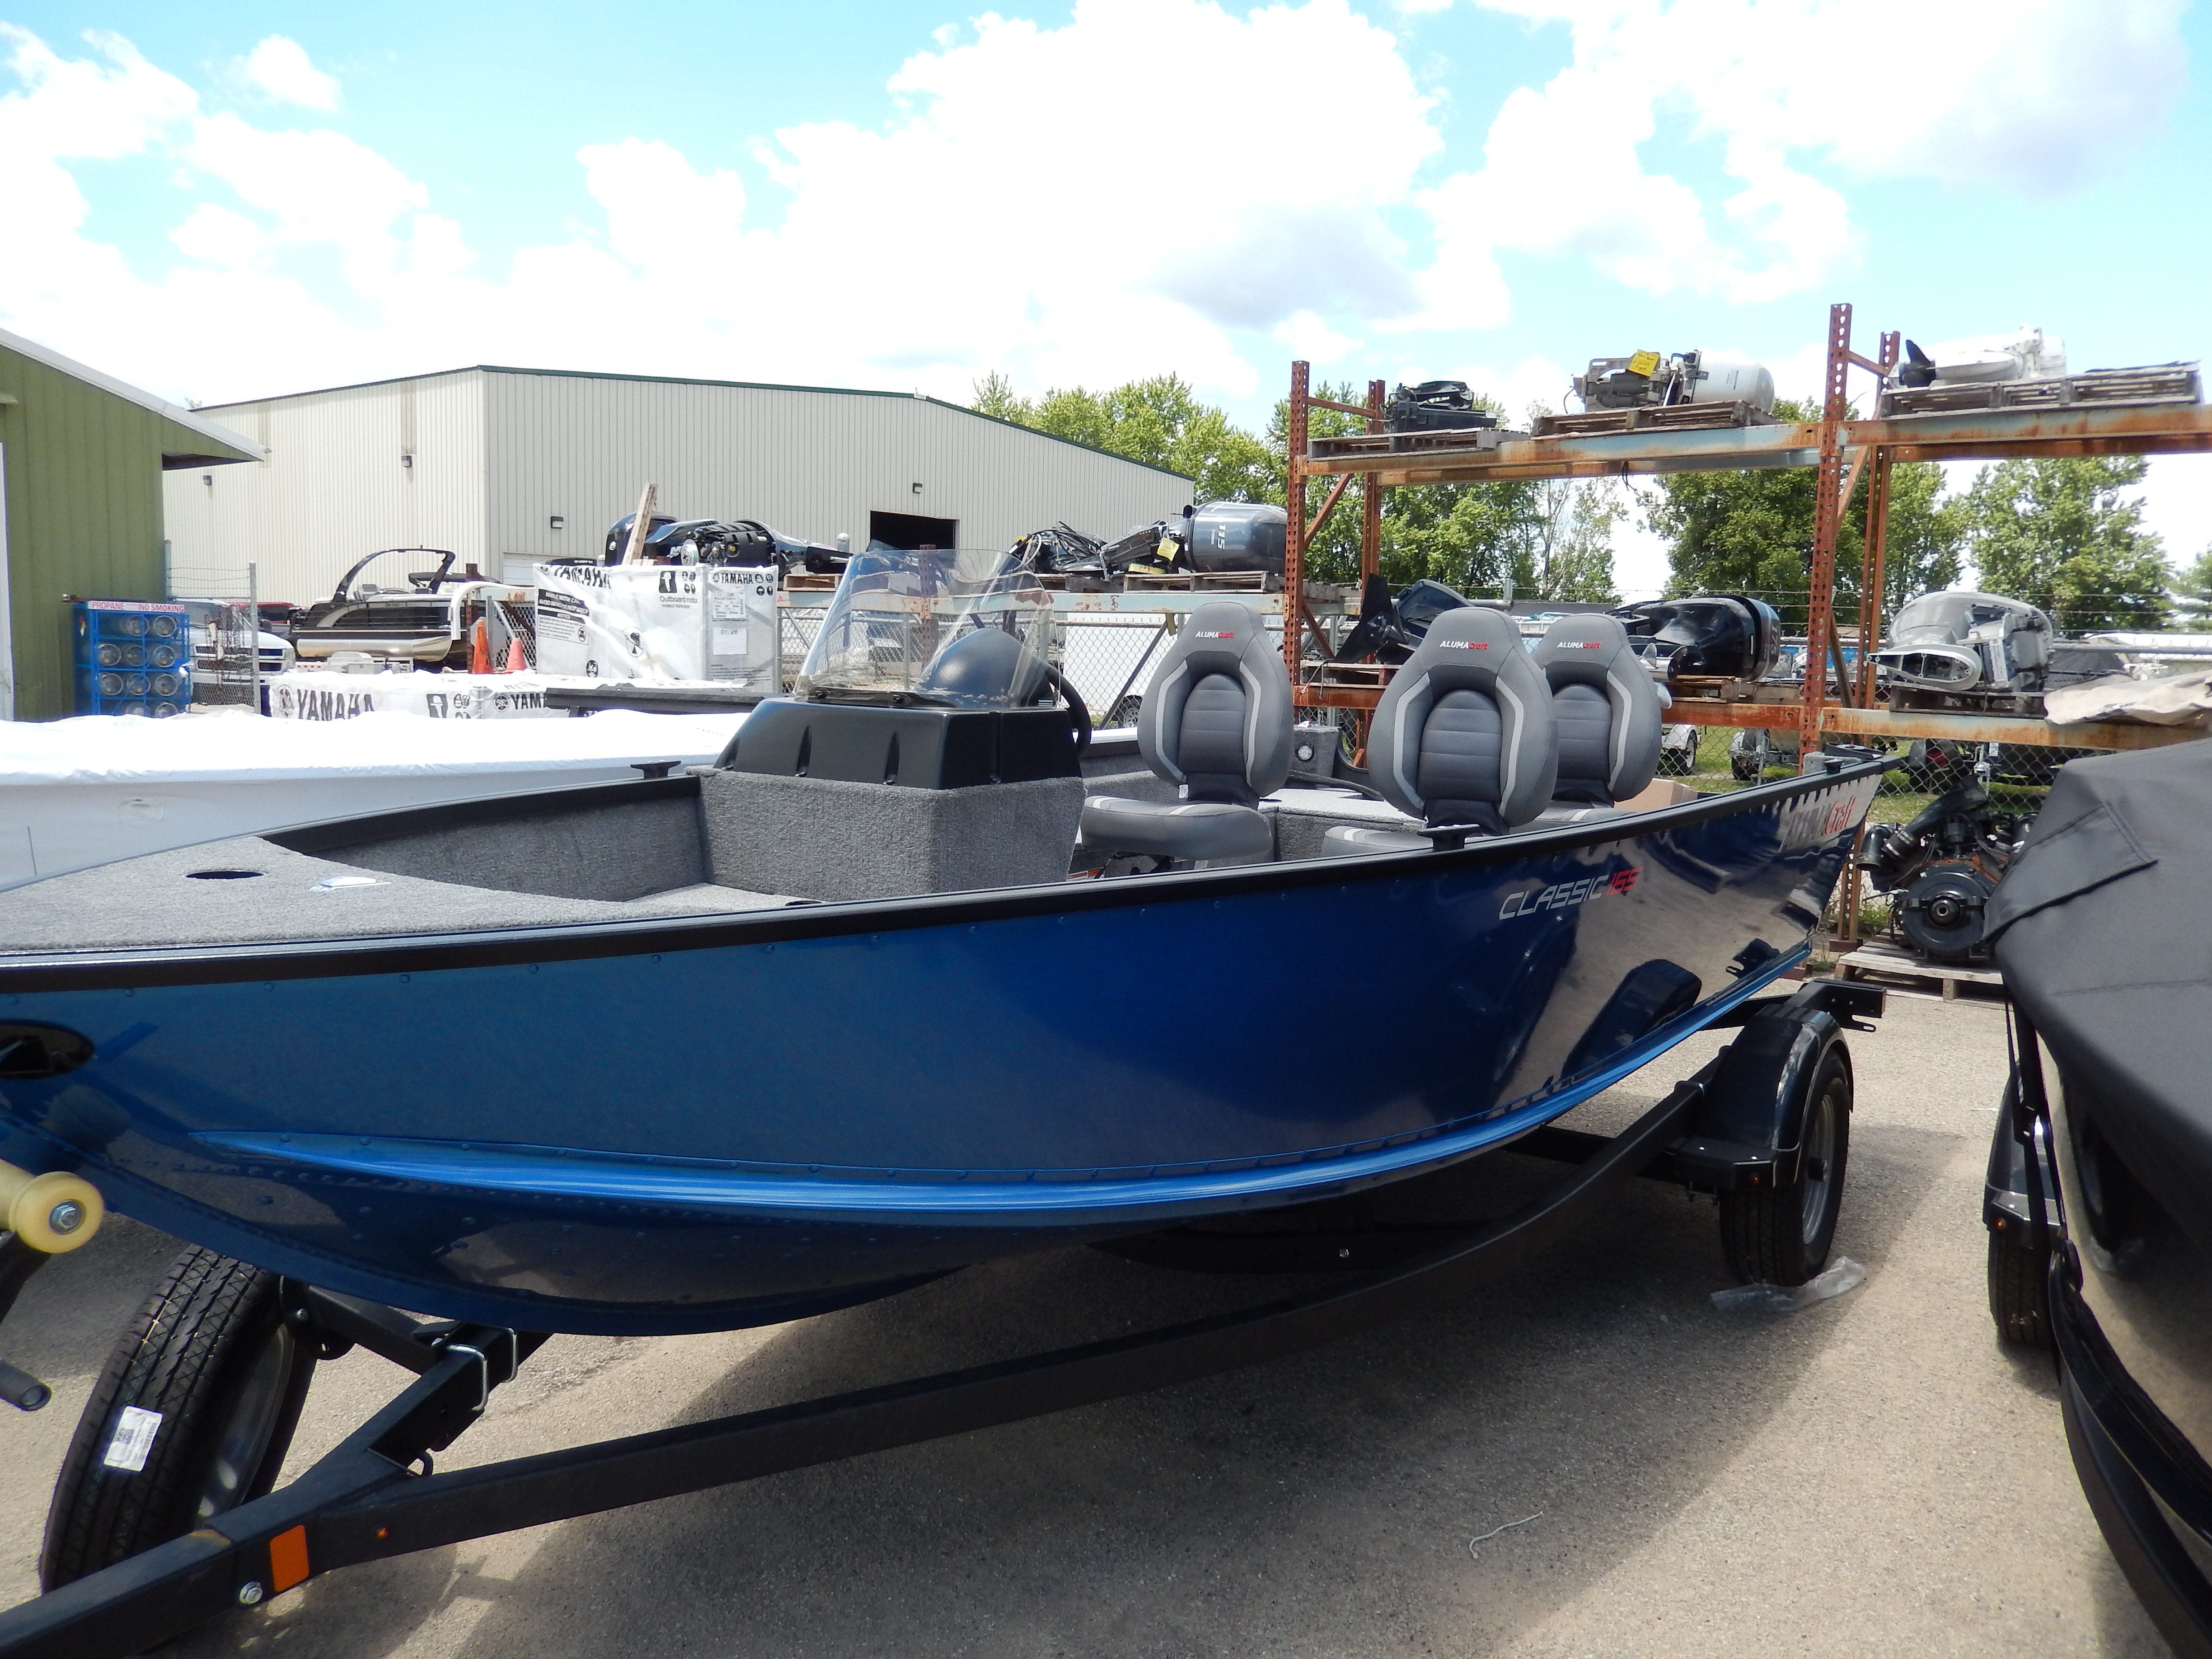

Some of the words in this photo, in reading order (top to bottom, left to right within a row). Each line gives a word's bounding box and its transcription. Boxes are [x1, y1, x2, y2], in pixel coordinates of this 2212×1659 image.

[721, 572, 754, 584] YAMAHA
[92, 601, 124, 609] PROPANE
[1439, 640, 1489, 650] ALUMACraft
[511, 692, 547, 710] YAM
[1499, 875, 1609, 920] CLASSIC
